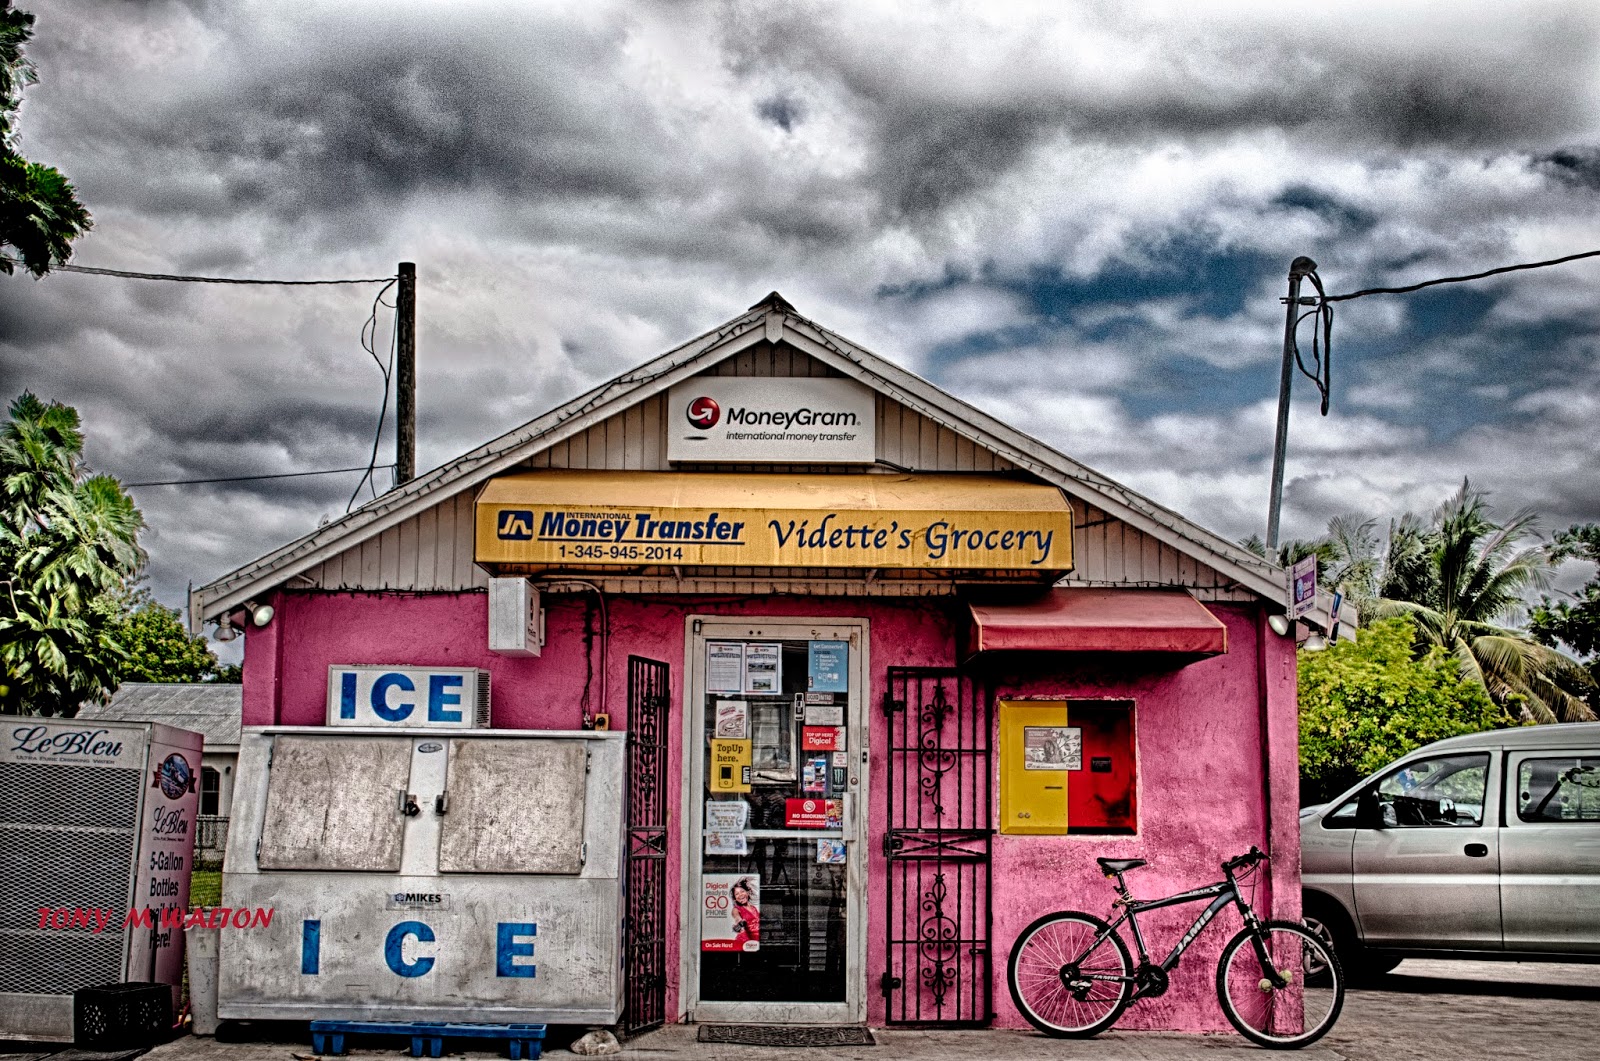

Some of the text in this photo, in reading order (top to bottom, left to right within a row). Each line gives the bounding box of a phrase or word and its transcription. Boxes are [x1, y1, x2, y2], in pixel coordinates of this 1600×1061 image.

[726, 407, 857, 430] MoneyGram
[726, 431, 857, 443] international money transfer
[566, 512, 632, 520] INTERNATIONAL
[539, 511, 745, 543] Money Transfer
[768, 513, 1054, 565] Vidette's Grocery
[559, 545, 683, 561] 1-345-945-2014
[340, 672, 464, 722] ICE
[717, 744, 744, 754] TopUp
[808, 737, 831, 746] Digicel
[717, 754, 739, 762] here.
[150, 851, 184, 871] 5-Gallon
[150, 877, 179, 897] Bottles
[705, 882, 729, 890] Digicel
[405, 893, 442, 902] MIKES
[705, 895, 729, 909] GO
[1176, 908, 1213, 955] JAMIS
[301, 919, 537, 978] ICE
